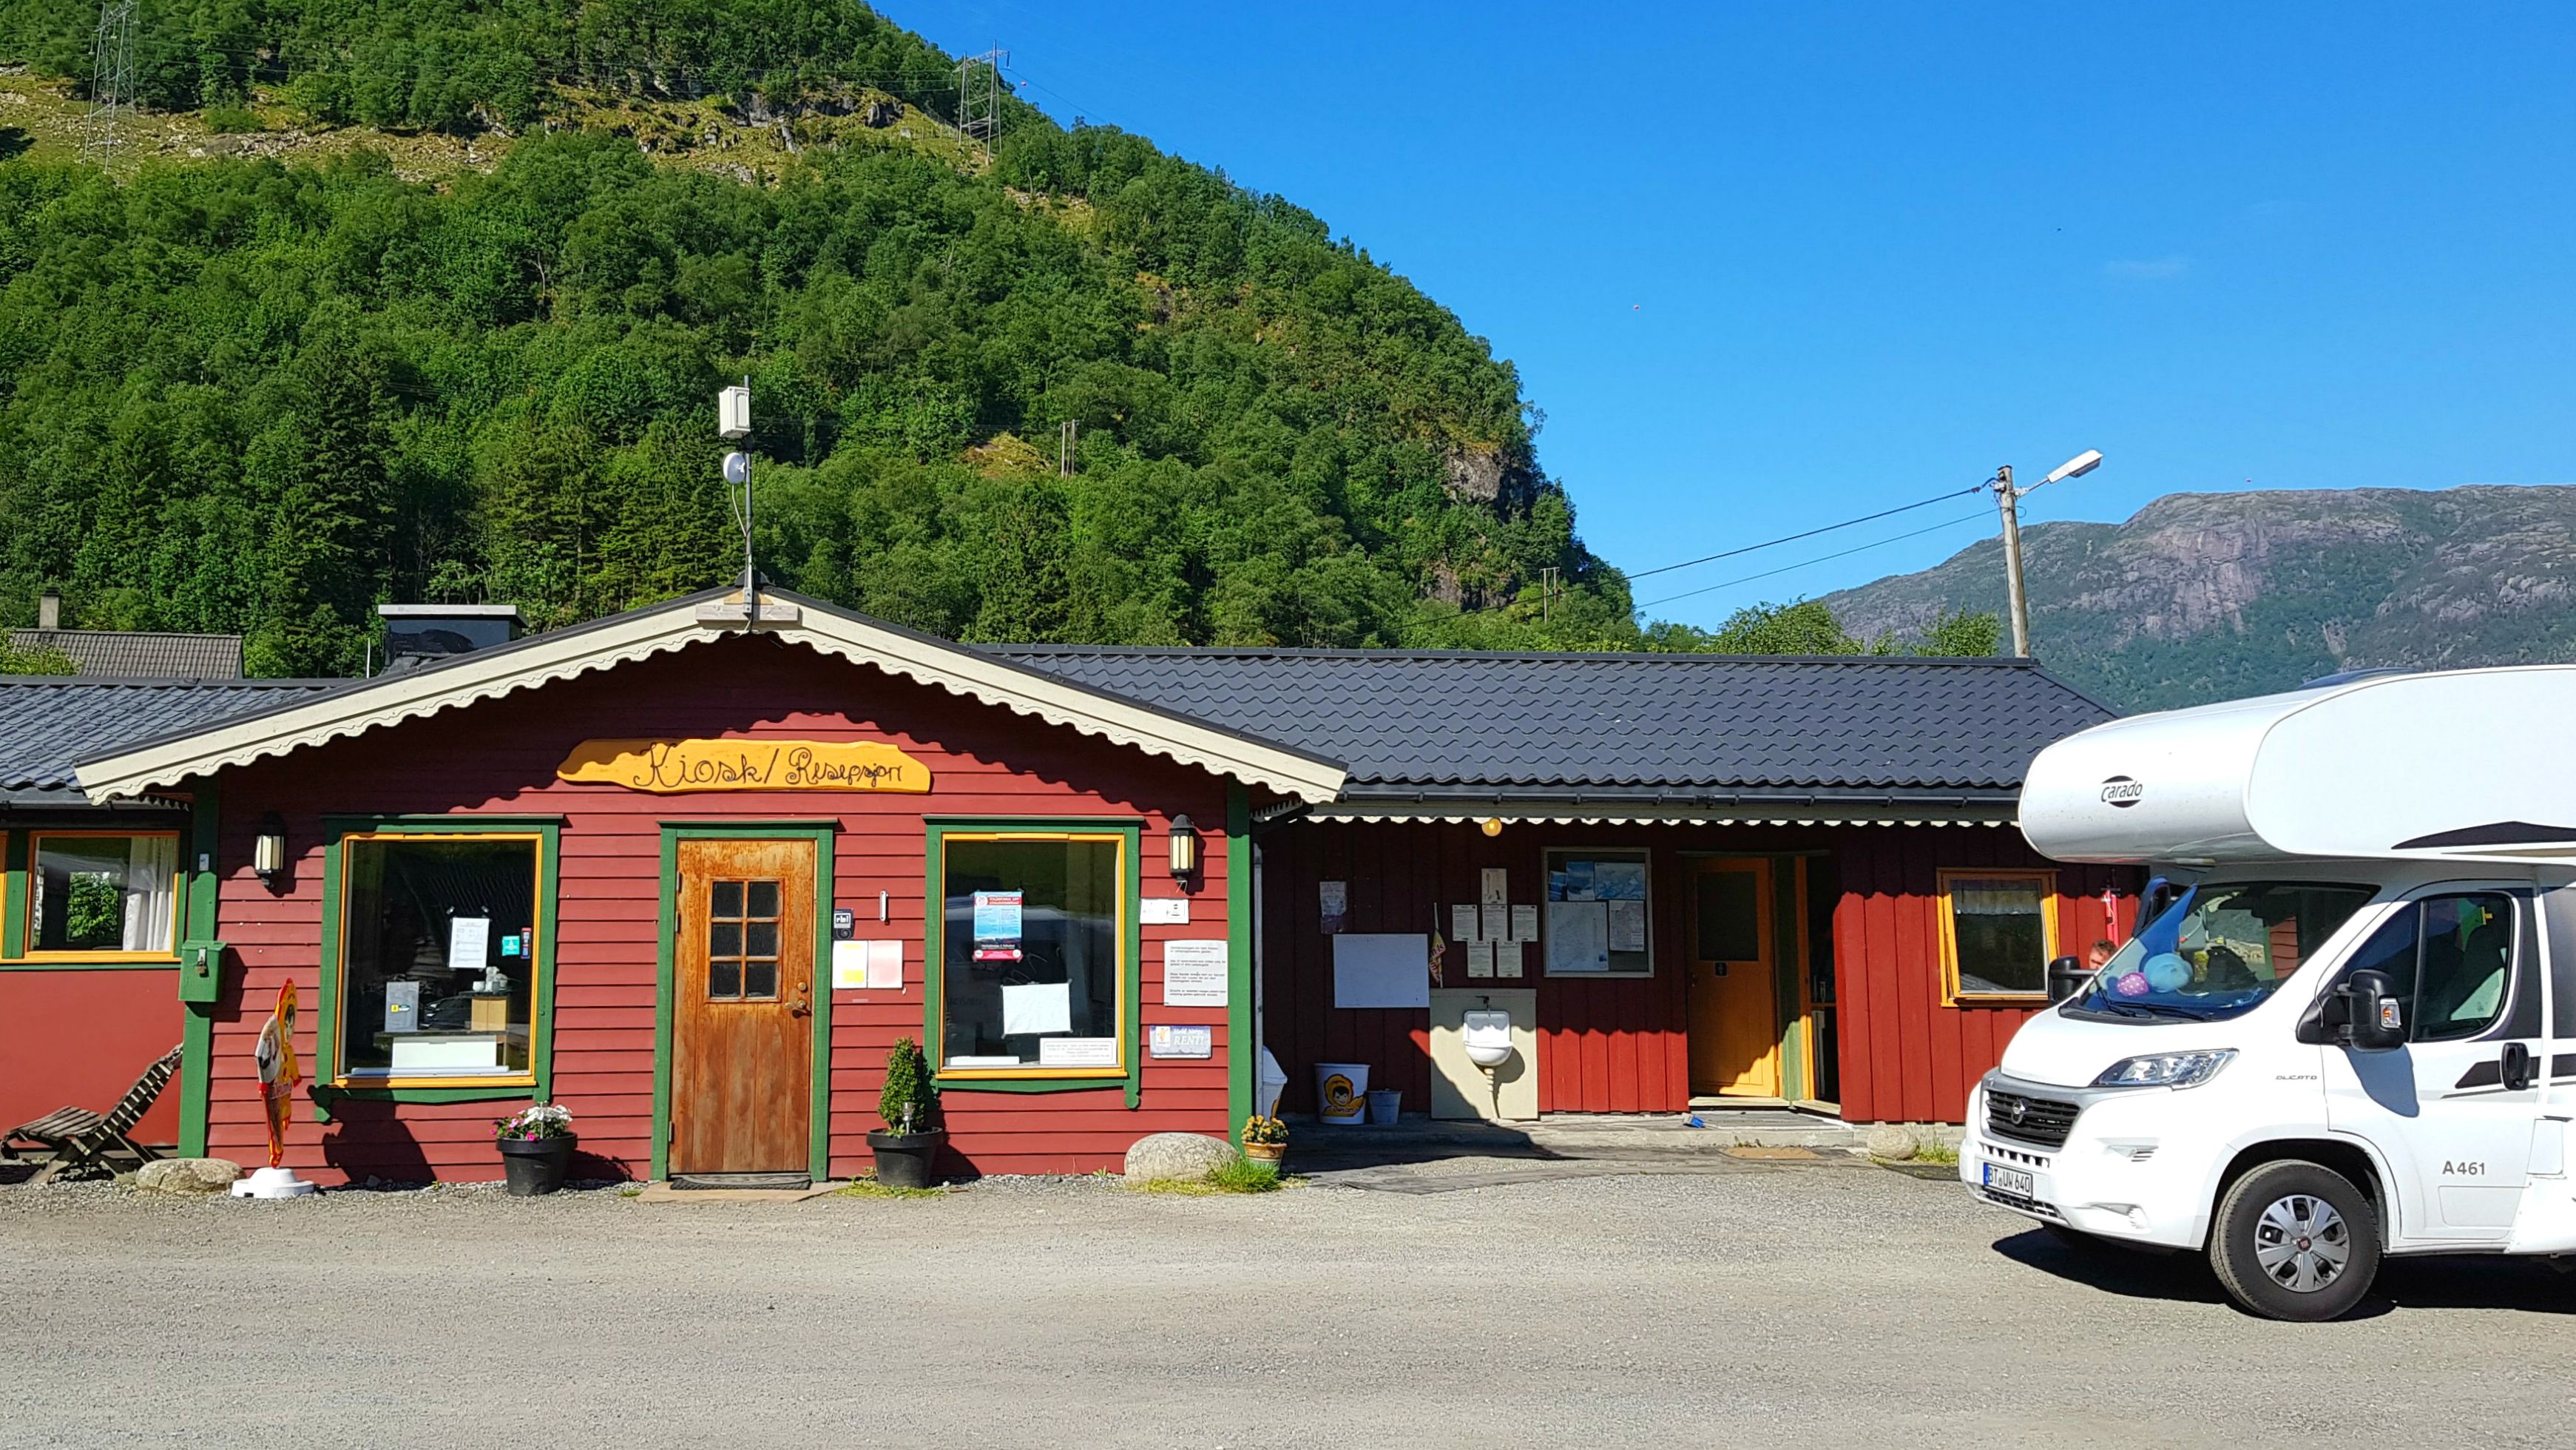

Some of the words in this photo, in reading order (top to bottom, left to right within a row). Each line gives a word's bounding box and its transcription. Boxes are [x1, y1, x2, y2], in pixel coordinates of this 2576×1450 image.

[785, 747, 902, 787] Resepsjon
[836, 915, 849, 923] rbl
[1173, 1035, 1204, 1045] RENT!
[2015, 1174, 2030, 1193] 640
